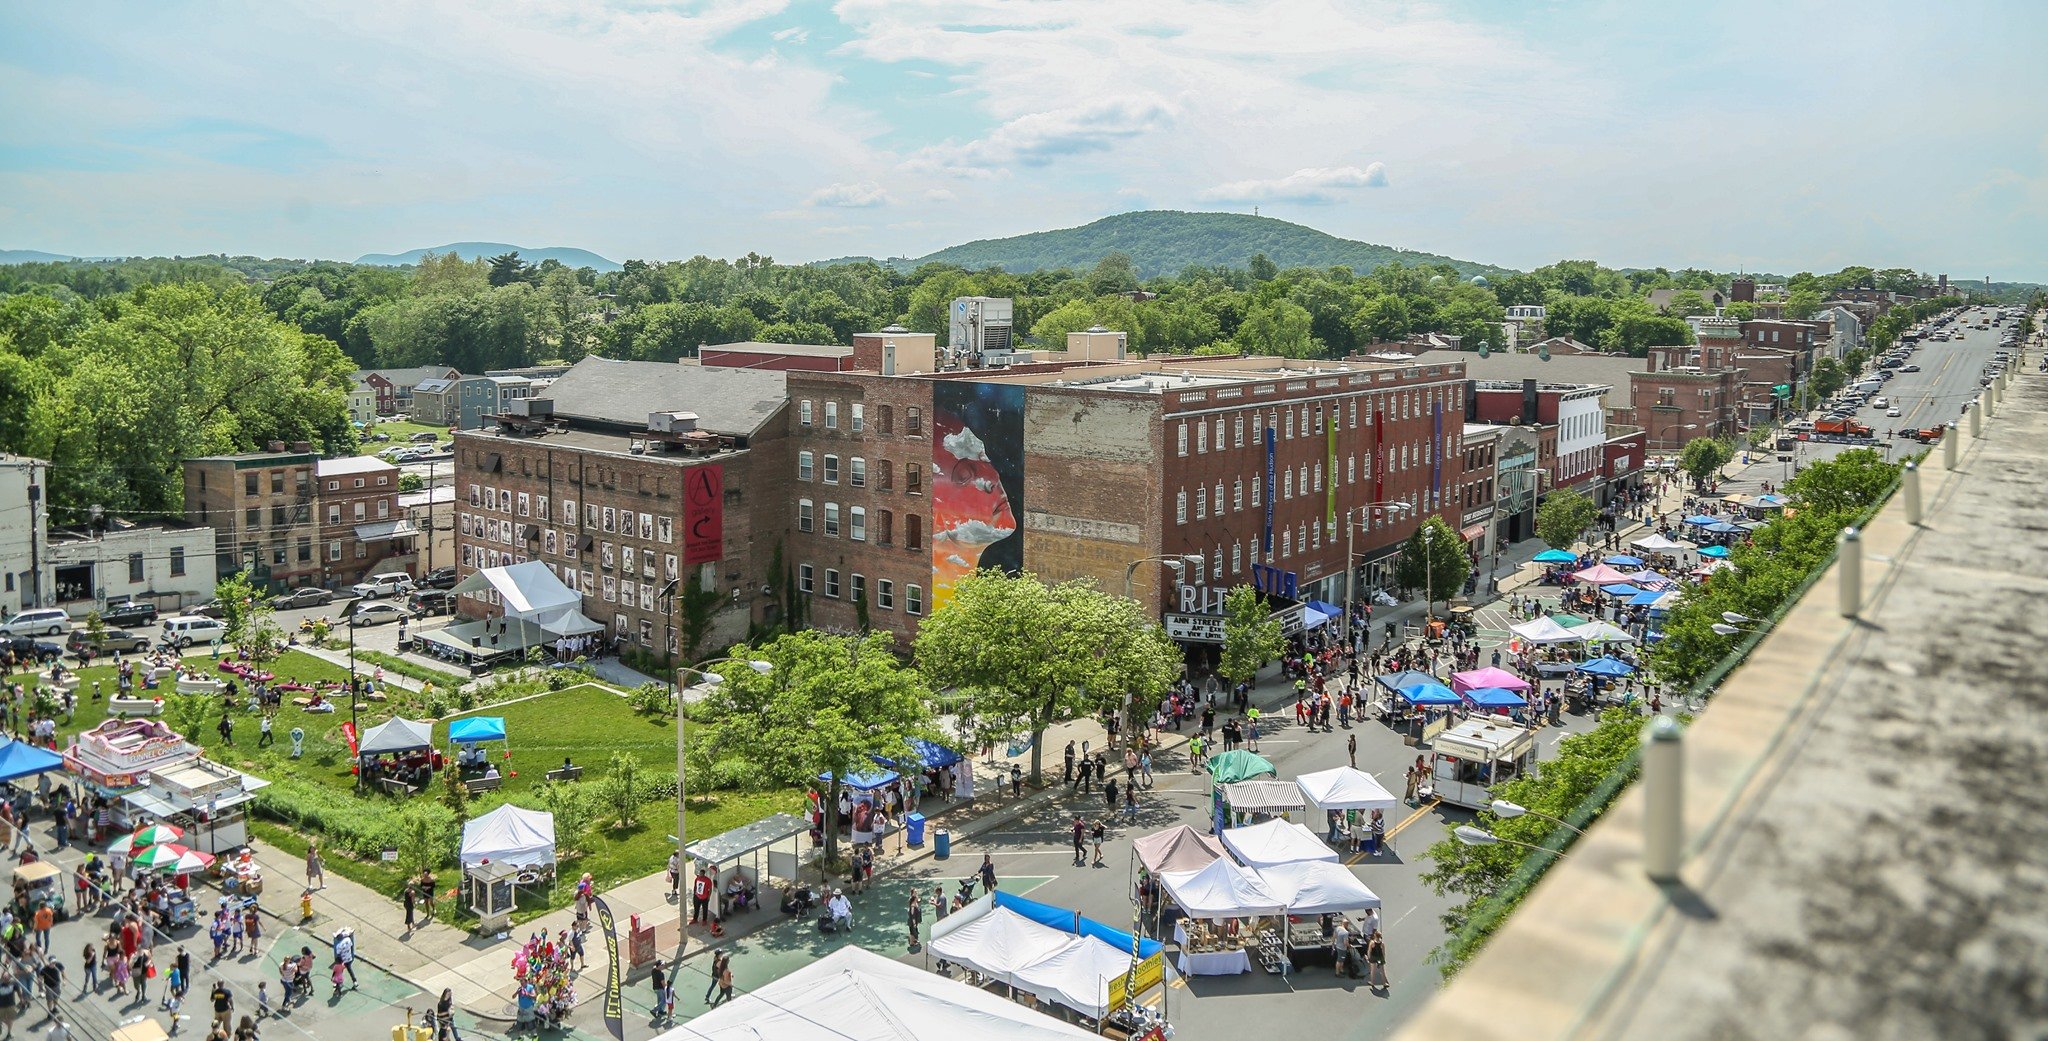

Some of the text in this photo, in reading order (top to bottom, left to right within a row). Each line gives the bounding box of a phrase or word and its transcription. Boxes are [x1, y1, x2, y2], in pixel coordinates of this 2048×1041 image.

[1181, 585, 1227, 615] RIT
[1173, 616, 1221, 626] ANN STREET
